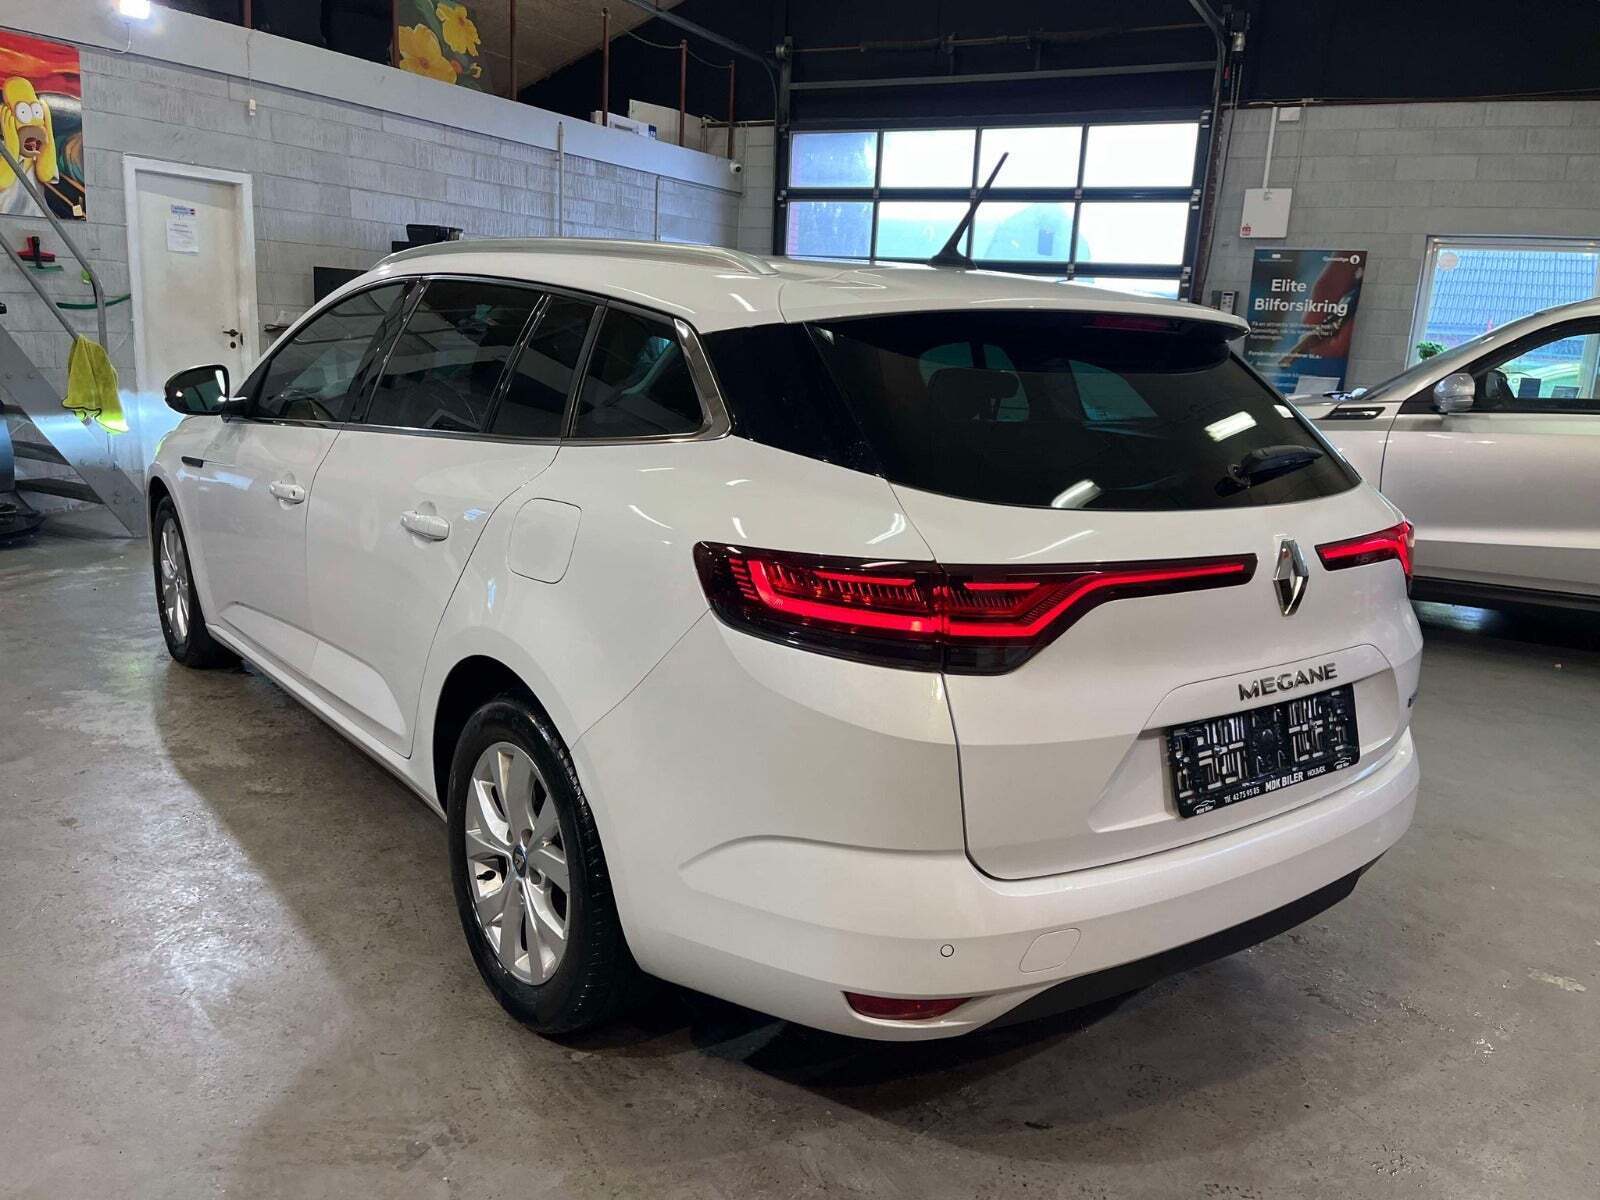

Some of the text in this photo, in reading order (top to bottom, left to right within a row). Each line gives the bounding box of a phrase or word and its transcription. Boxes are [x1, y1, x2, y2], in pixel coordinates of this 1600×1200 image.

[1271, 279, 1307, 292] Elite
[1254, 298, 1348, 316] Bilforsikring
[1238, 663, 1338, 701] MEGANE
[1265, 780, 1281, 792] MDK
[1282, 771, 1303, 787] BILER
